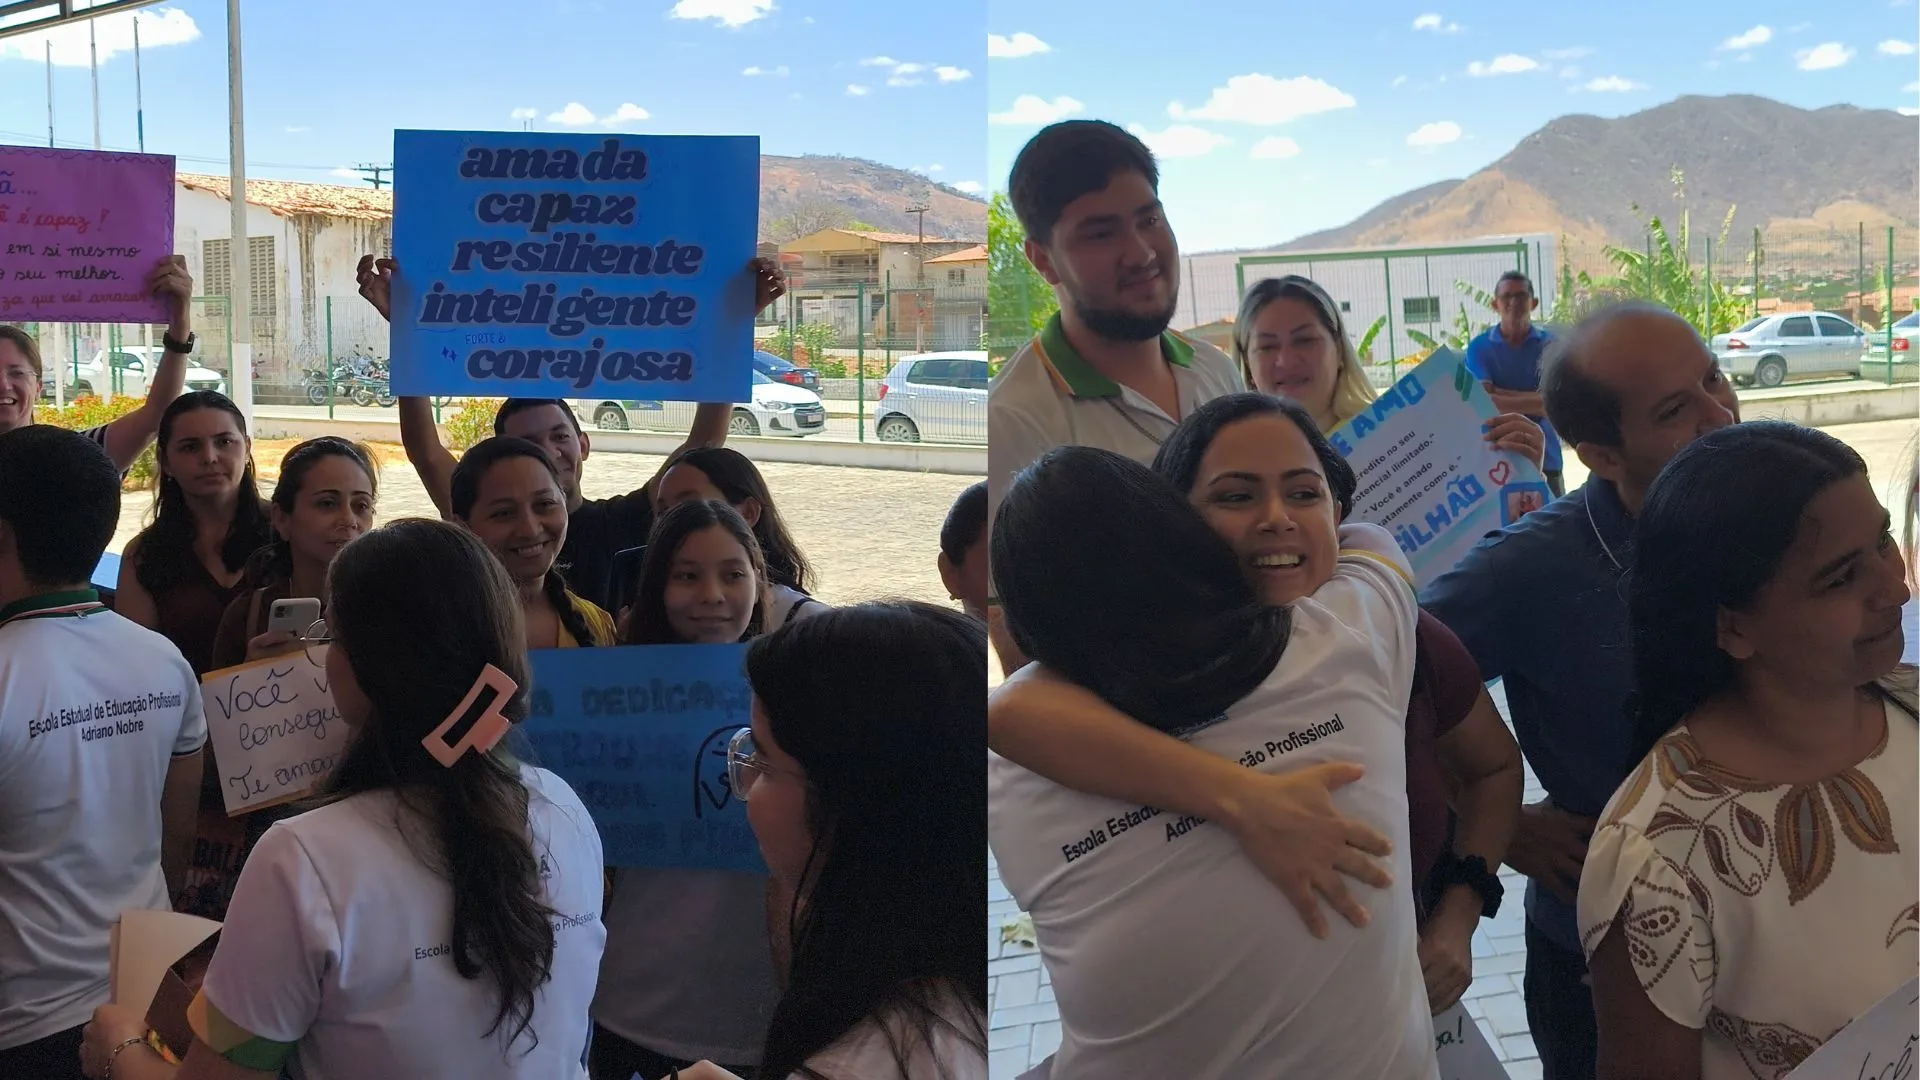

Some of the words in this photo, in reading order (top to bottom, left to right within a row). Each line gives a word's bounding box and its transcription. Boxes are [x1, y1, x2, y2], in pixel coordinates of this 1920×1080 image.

[460, 139, 647, 181] amada
[478, 193, 637, 233] capaz
[6, 243, 35, 255] em
[41, 243, 61, 257] si
[68, 247, 141, 258] mesmo
[452, 232, 703, 275] resiliente
[14, 270, 46, 281] seu
[31, 293, 56, 309] que
[420, 282, 697, 336] inteligente
[467, 338, 693, 389] corajosa
[1351, 372, 1427, 439] AMO
[1355, 455, 1387, 481] credito
[1387, 445, 1398, 457] no
[1398, 430, 1417, 447] seu
[1403, 461, 1433, 488] amado
[1423, 470, 1448, 492] como
[215, 666, 299, 720] Você
[28, 712, 59, 739] Escola
[60, 703, 93, 727] Estadual
[94, 705, 104, 720] de
[105, 695, 147, 717] Educação
[148, 691, 181, 711] Profissional
[81, 724, 114, 743] Adriano
[116, 719, 144, 735] Nobre
[229, 765, 271, 801] Te
[1062, 829, 1107, 864] Escola
[1264, 713, 1345, 758] Profissional
[415, 943, 450, 960] Escola
